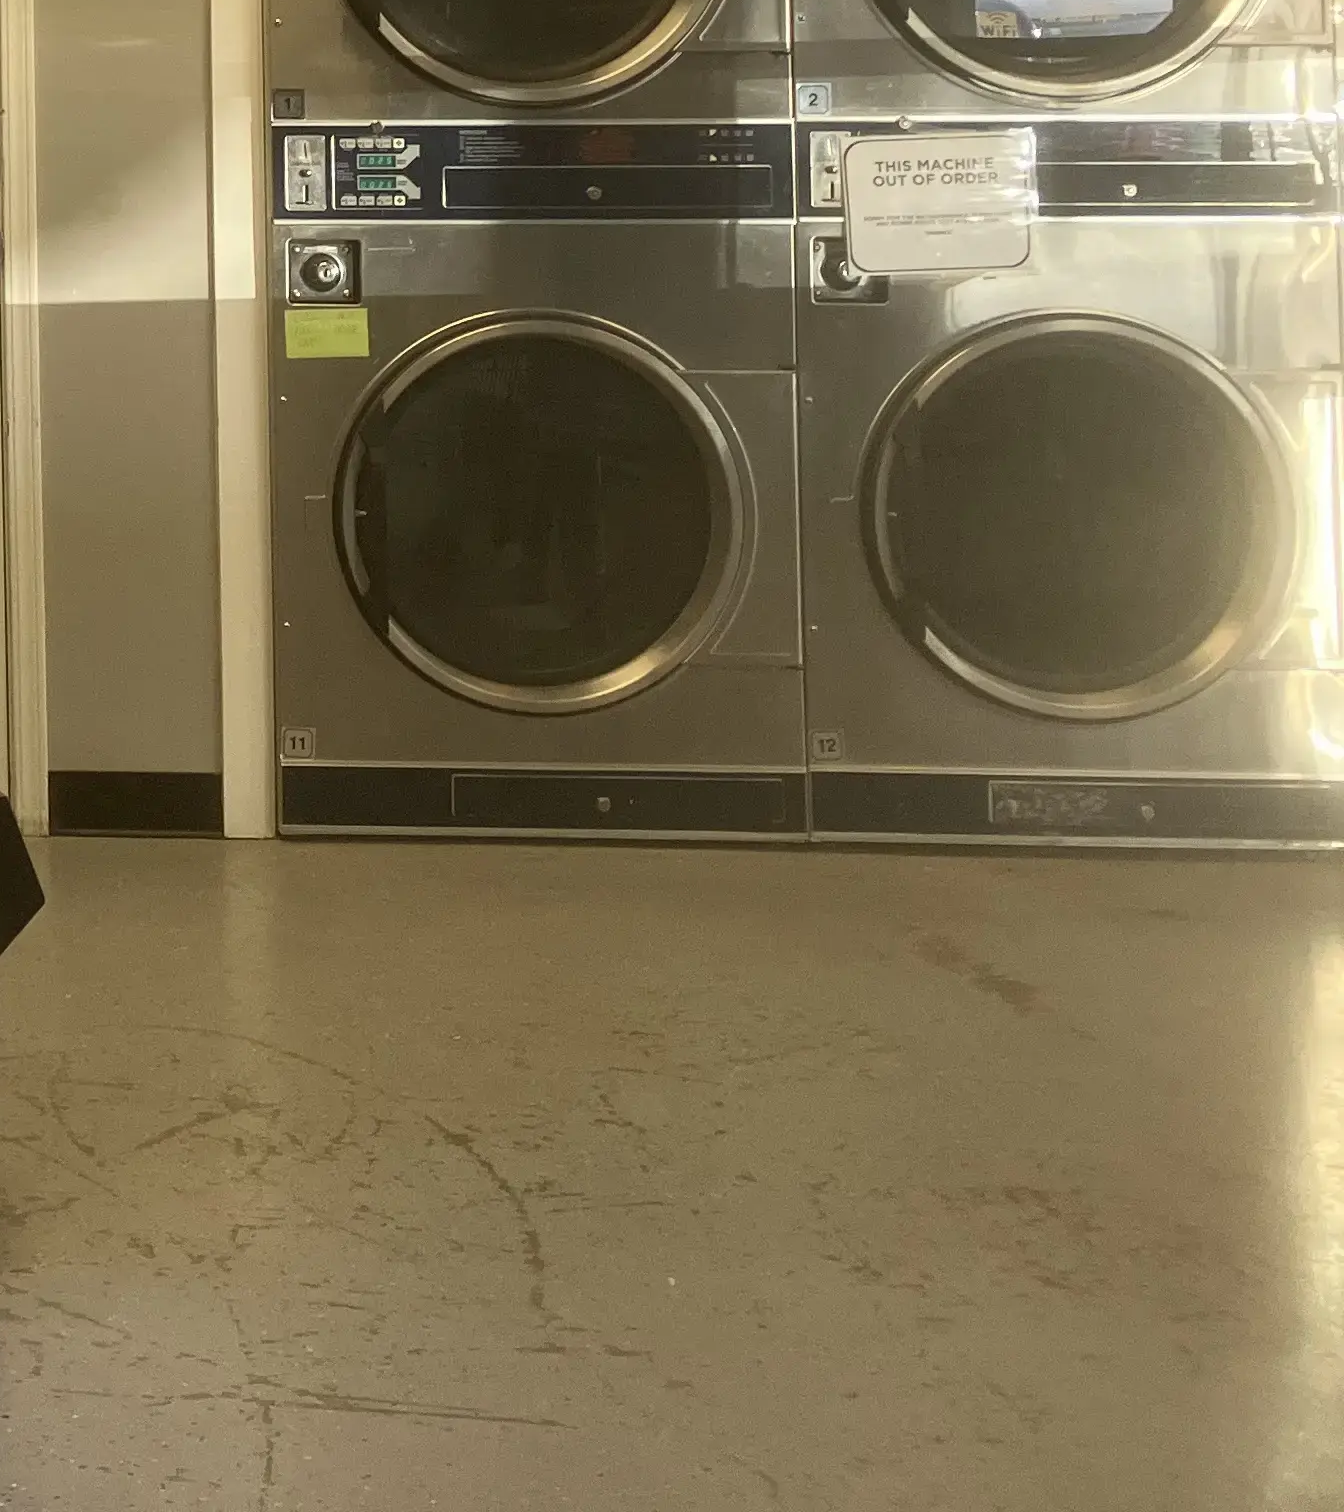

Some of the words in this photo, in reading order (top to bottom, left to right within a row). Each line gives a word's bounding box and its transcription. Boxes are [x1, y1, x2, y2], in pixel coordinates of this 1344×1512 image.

[284, 97, 291, 110] 1
[808, 92, 819, 107] 2
[874, 160, 912, 173] THIS
[872, 174, 908, 187] OUT
[912, 173, 936, 185] OF
[941, 171, 998, 184] ORDER
[289, 736, 306, 750] 11
[818, 738, 836, 753] 12
